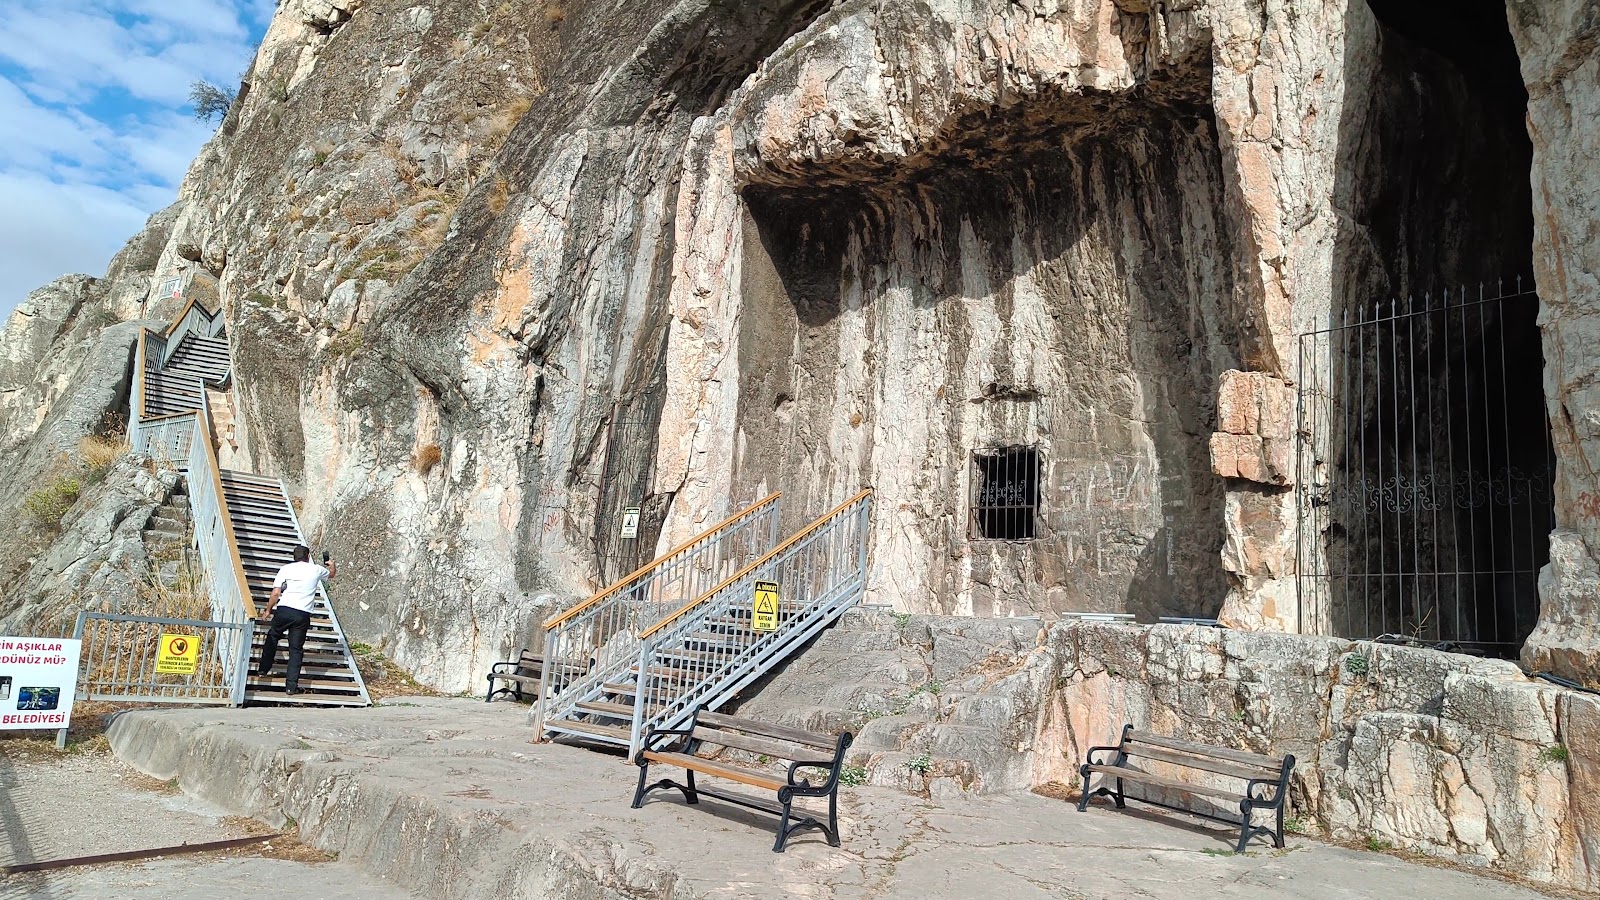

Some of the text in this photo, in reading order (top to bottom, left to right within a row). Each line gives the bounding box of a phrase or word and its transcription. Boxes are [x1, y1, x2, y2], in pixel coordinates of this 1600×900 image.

[0, 640, 62, 652] İN AŞIKLAR
[0, 654, 66, 665] DÜNÜZ MÜ?
[2, 712, 65, 723] BELEDİYESİ
